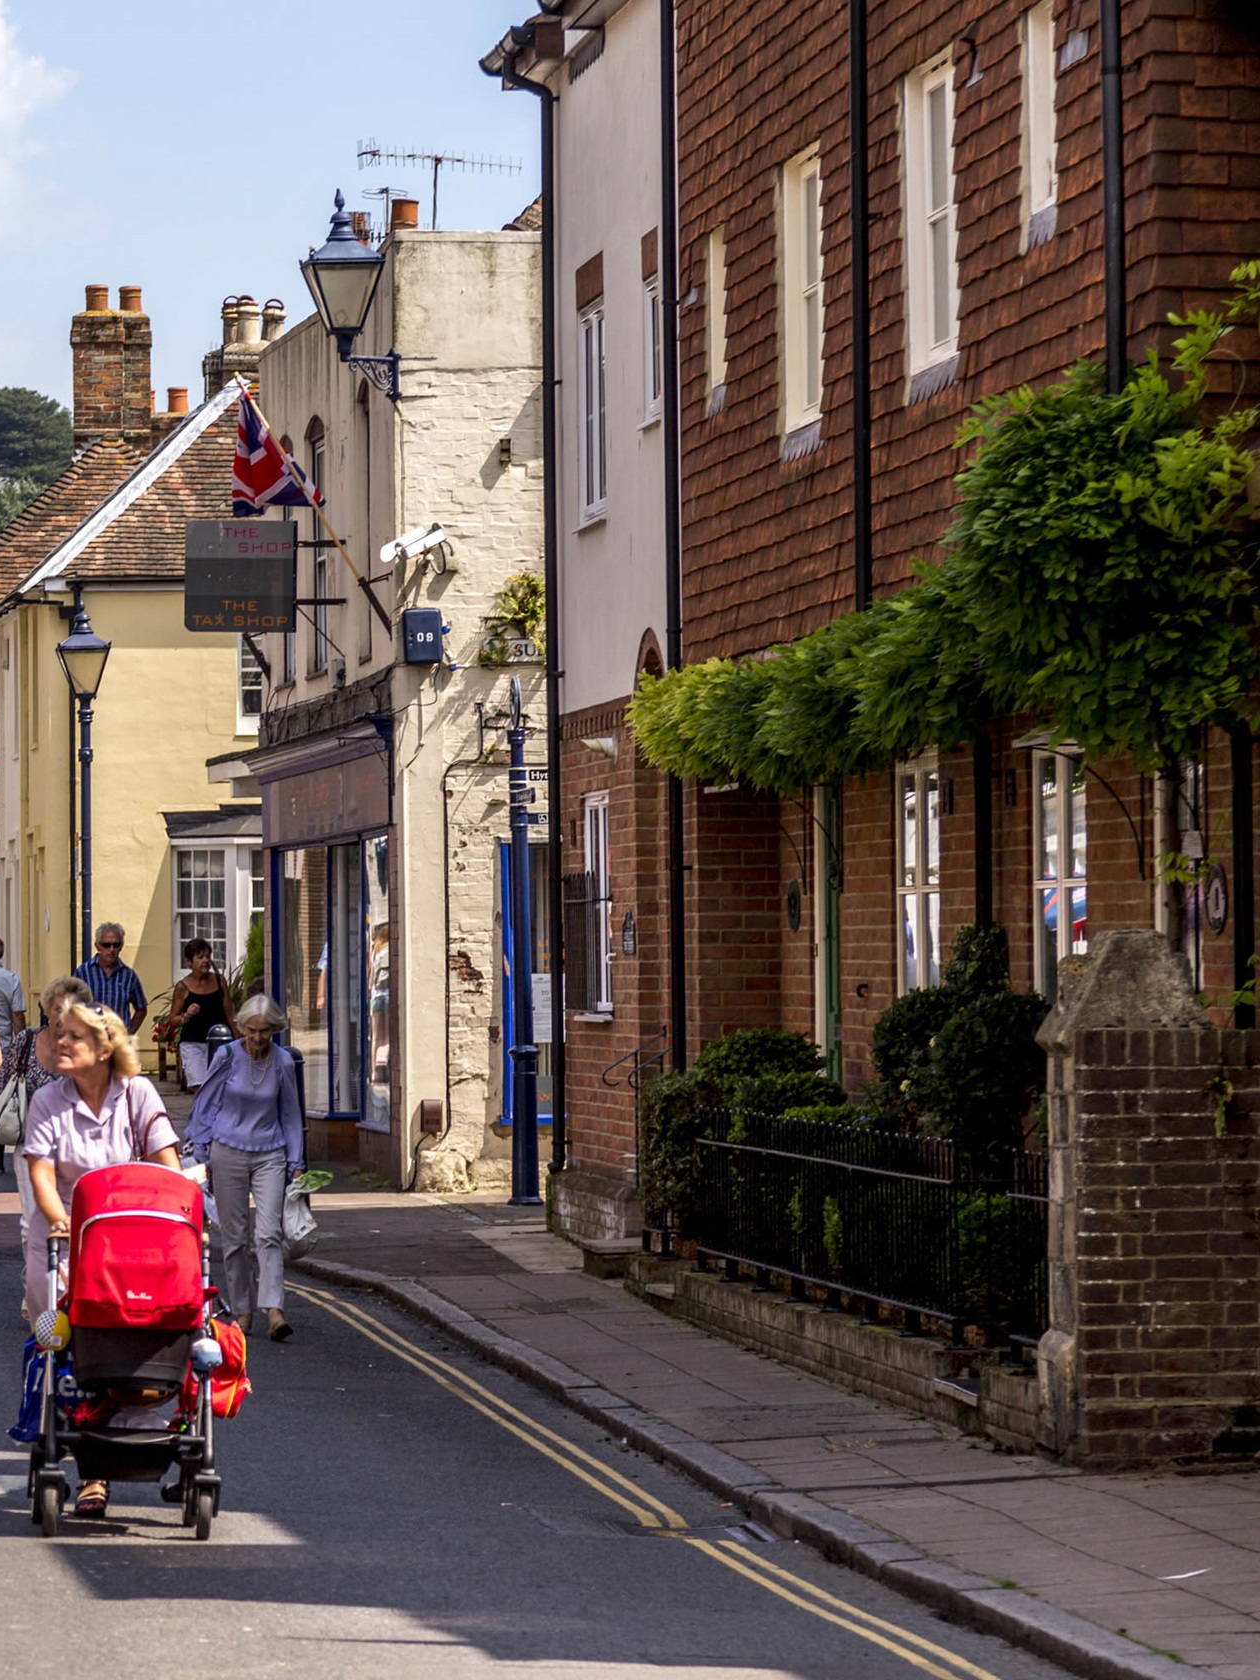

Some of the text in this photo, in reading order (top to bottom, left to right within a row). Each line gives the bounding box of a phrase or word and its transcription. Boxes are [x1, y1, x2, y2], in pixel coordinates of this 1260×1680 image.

[222, 527, 259, 539] THE
[237, 541, 293, 553] SHOP
[221, 600, 259, 612] THE
[191, 614, 289, 627] TAX SHOP
[416, 632, 434, 643] 09
[530, 771, 549, 781] Hyt
